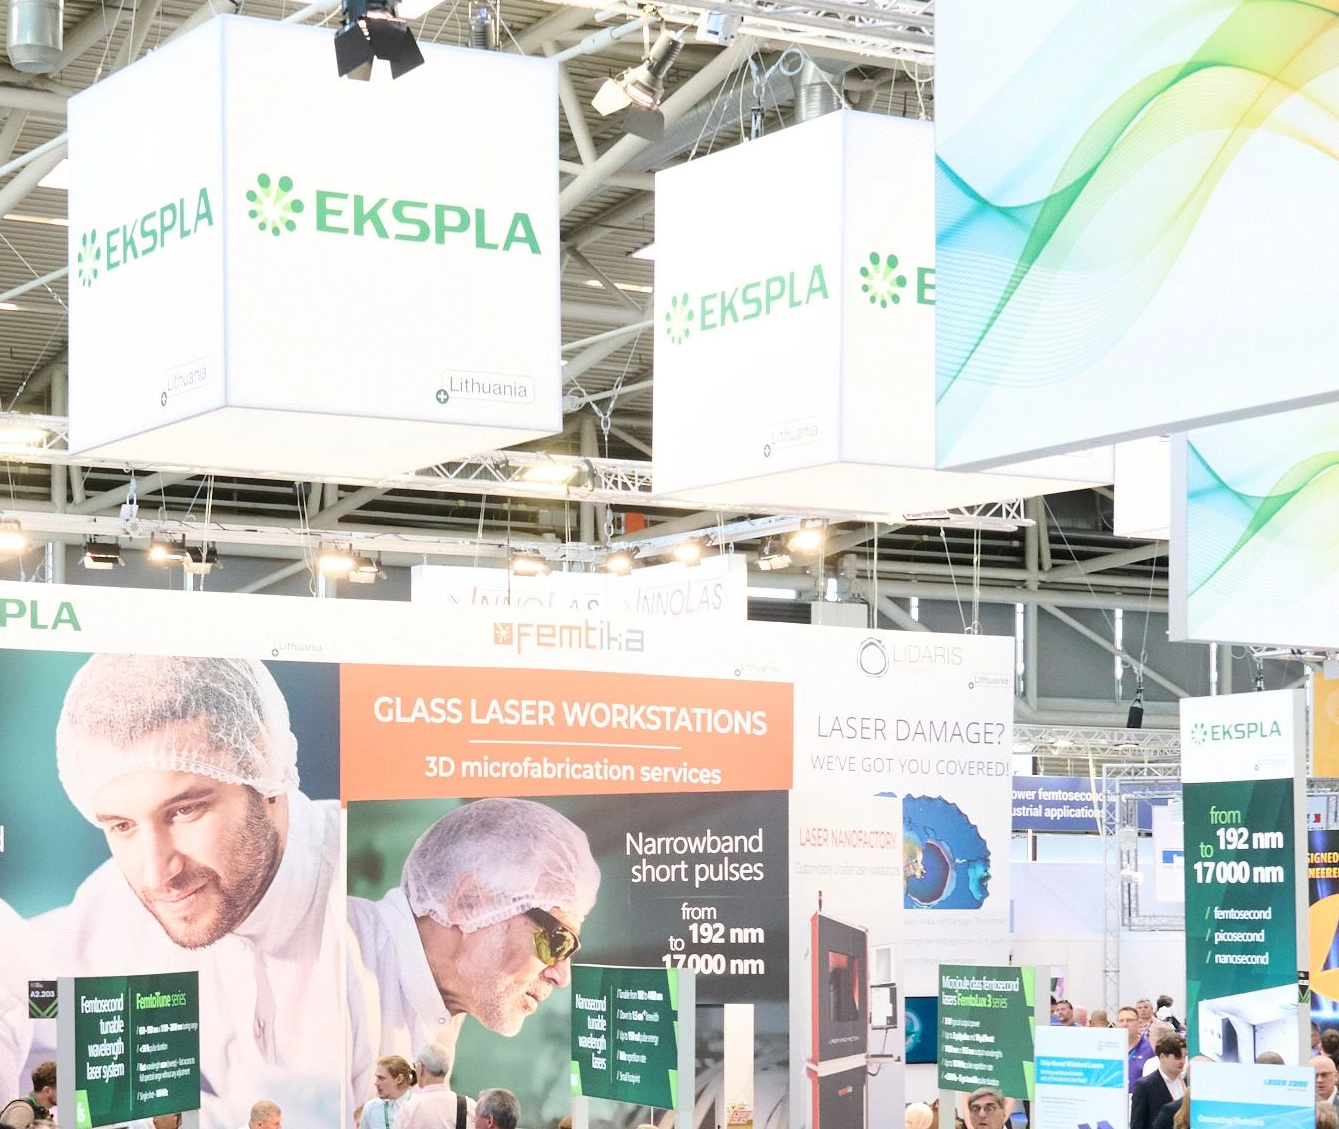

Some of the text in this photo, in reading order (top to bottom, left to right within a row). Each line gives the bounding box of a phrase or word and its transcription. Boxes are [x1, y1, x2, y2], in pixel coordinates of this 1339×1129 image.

[107, 187, 214, 272] EKSPLA
[317, 190, 542, 255] EKSPLA
[700, 263, 830, 332] EKSPLA
[166, 363, 207, 394] Lithuania
[449, 375, 529, 398] Lithuania
[892, 645, 963, 666] LIDARIS
[374, 696, 768, 736] GLASS LASER WORKSTATIONS
[817, 715, 1005, 745] LASER DAMAGE?
[1210, 721, 1282, 742] EKSPLA
[425, 756, 722, 786] 3D microfabrication services
[861, 757, 1010, 778] GOT YOU COVERED!
[1209, 806, 1241, 824] from
[626, 829, 764, 856] Narrowband
[799, 827, 897, 850] LASER NANOFACTORY
[1216, 827, 1283, 850] 192 nm
[1200, 842, 1213, 859] to
[631, 857, 689, 882] short
[694, 858, 764, 887] pulses
[1253, 865, 1283, 883] nm
[681, 903, 717, 920] from
[1213, 906, 1272, 921] femtosecond
[669, 934, 685, 952] to
[689, 924, 764, 944] 192 nm
[1214, 929, 1265, 944] picosecond
[730, 958, 764, 975] nm
[1215, 951, 1269, 966] nanosecond
[983, 976, 1020, 992] femtosecond
[81, 993, 124, 1014] Femtosecond
[136, 989, 187, 1010] FemtoTune series
[576, 994, 607, 1012] Nanosecond
[100, 1015, 124, 1035] tunable
[588, 1014, 607, 1032] tunable
[88, 1037, 124, 1060] wavelength
[578, 1033, 607, 1055] wavelength
[86, 1062, 102, 1080] laser
[102, 1061, 125, 1083] system
